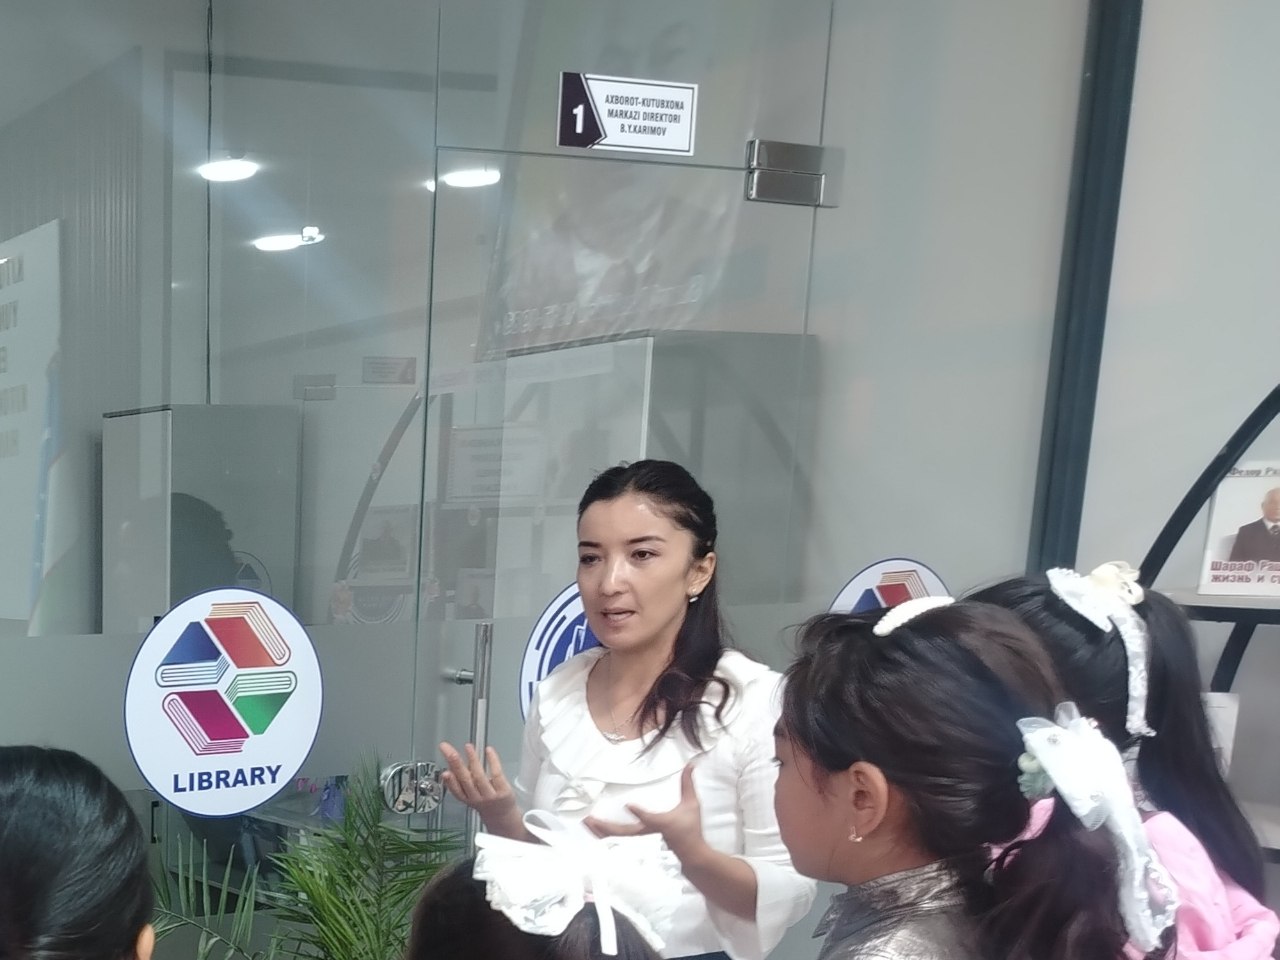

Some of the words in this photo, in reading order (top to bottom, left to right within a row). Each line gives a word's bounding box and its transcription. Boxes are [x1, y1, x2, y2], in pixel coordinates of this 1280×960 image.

[604, 94, 685, 111] AXBOROT-KUTUBXONA
[572, 104, 585, 134] 1
[607, 108, 641, 121] MARKAZI
[642, 111, 681, 124] DIREKTORI
[1210, 561, 1255, 571] Шараф
[1256, 574, 1265, 583] и
[173, 764, 283, 794] LIBRARY
